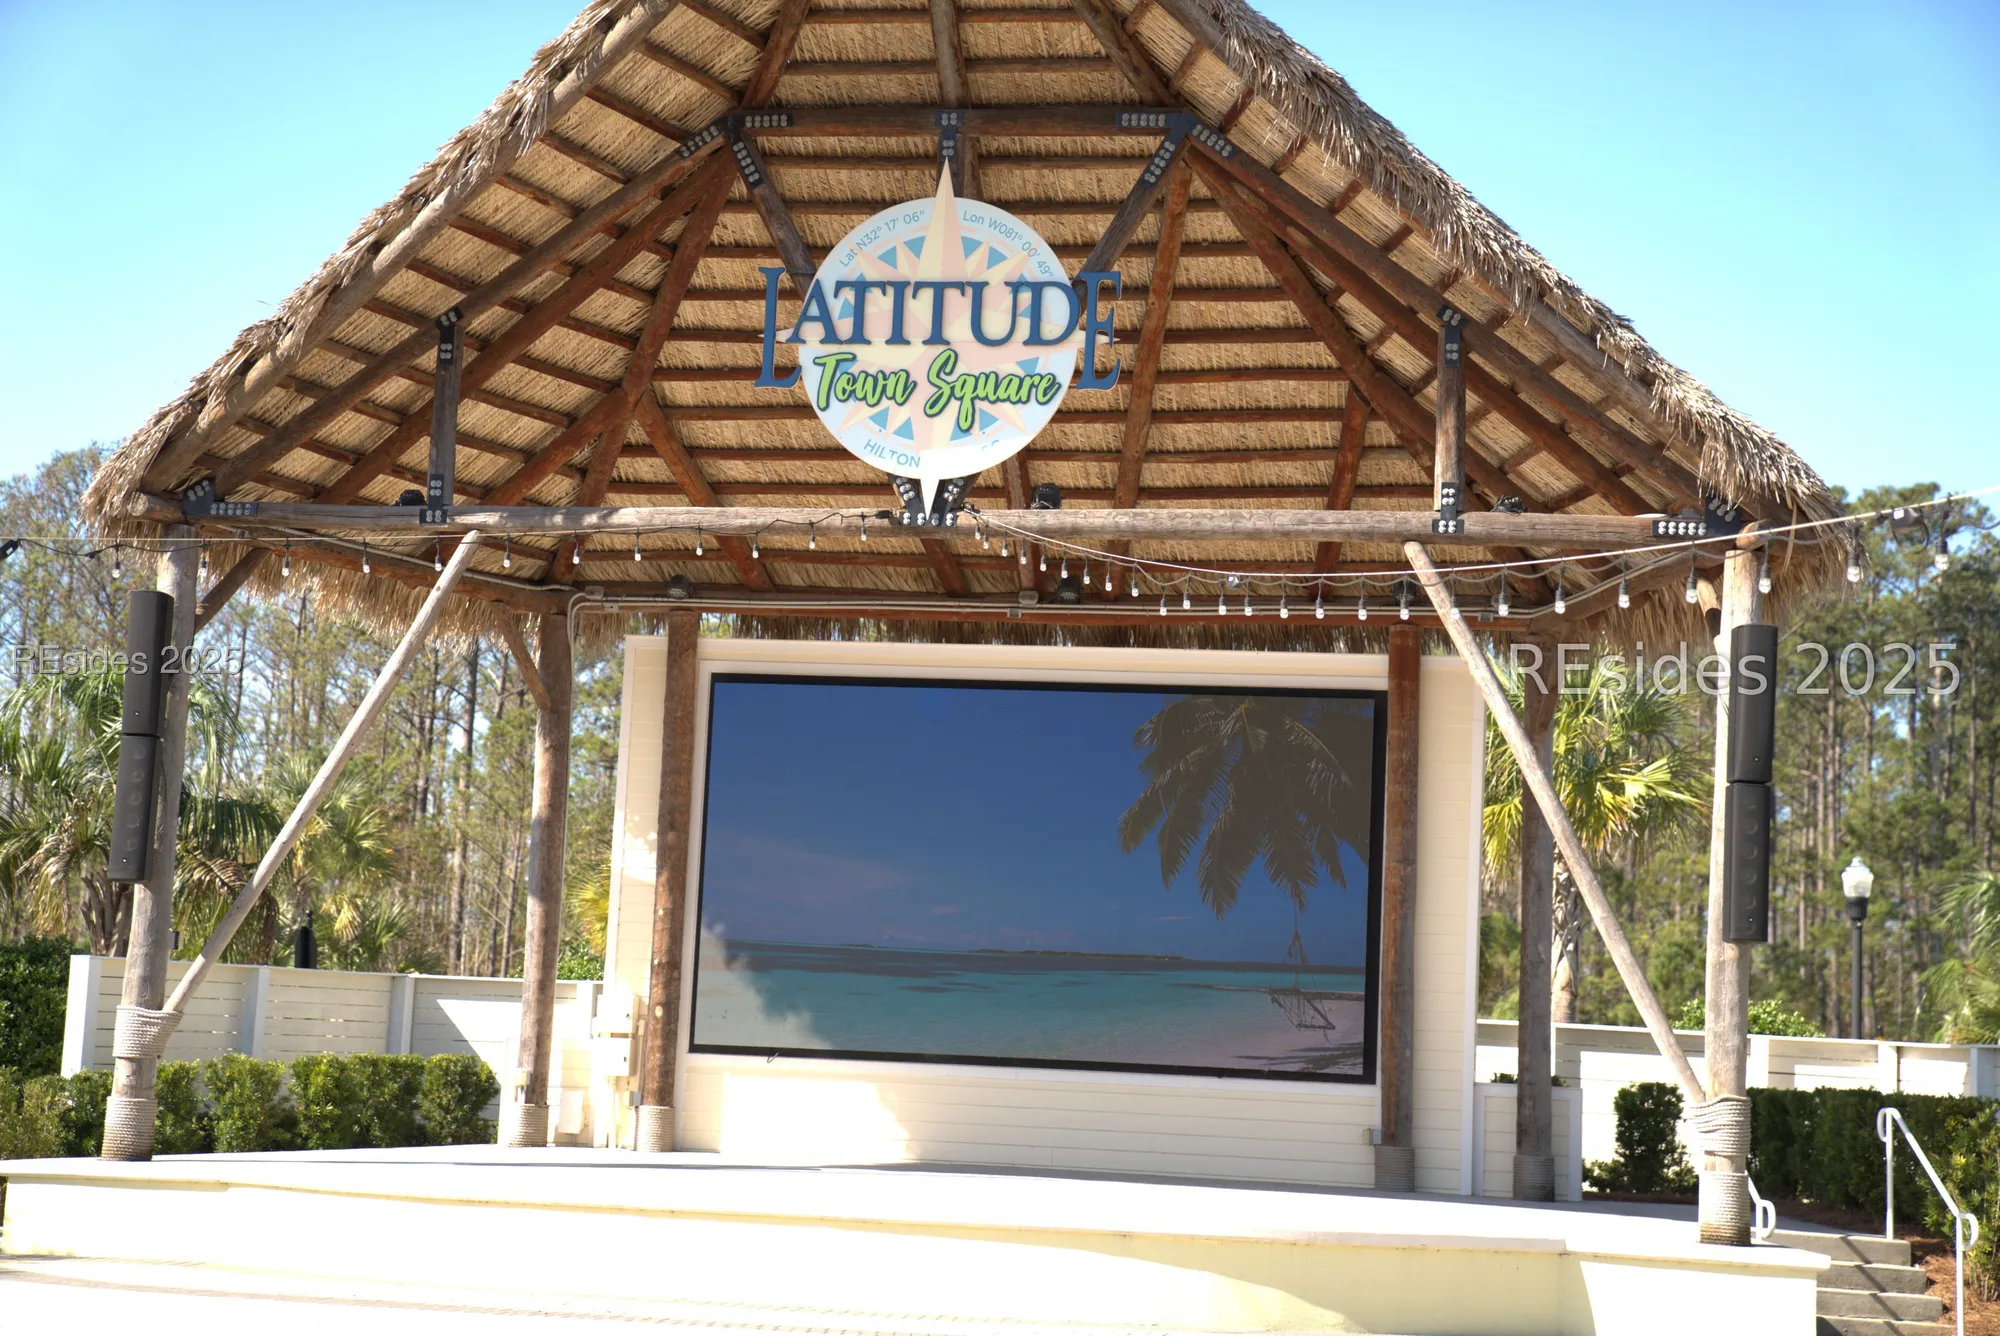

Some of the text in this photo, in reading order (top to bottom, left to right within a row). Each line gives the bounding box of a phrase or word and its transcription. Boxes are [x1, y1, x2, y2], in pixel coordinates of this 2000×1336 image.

[962, 210, 985, 225] Lon
[839, 247, 859, 267] Lat
[754, 266, 1122, 391] LATITUDE
[813, 348, 1062, 432] Town Square
[864, 439, 921, 468] HILTON
